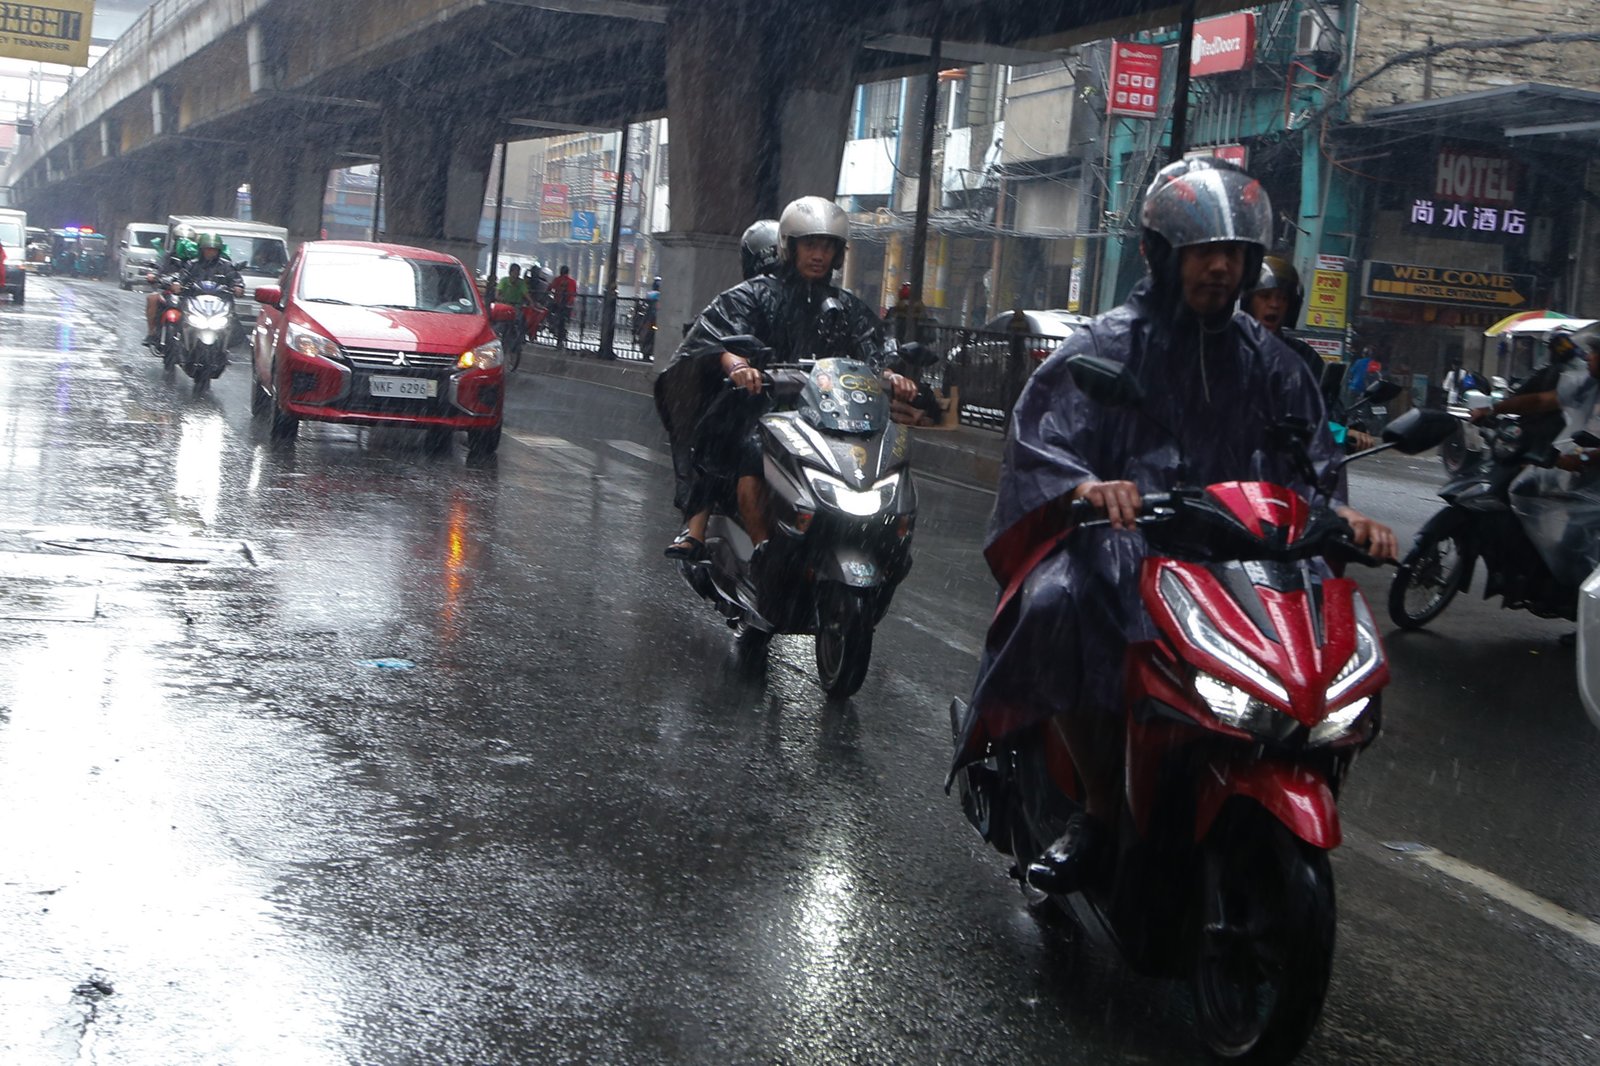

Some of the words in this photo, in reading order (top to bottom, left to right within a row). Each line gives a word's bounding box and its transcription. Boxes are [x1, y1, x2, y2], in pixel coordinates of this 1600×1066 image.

[13, 37, 70, 51] TRANSFER
[1436, 153, 1515, 201] HOTEL
[1411, 199, 1527, 234] 尚水酒店
[1391, 265, 1514, 288] WELCOME
[1413, 285, 1445, 297] HOTEL
[1446, 287, 1497, 300] ENTRANCE
[400, 382, 427, 395] 6296
